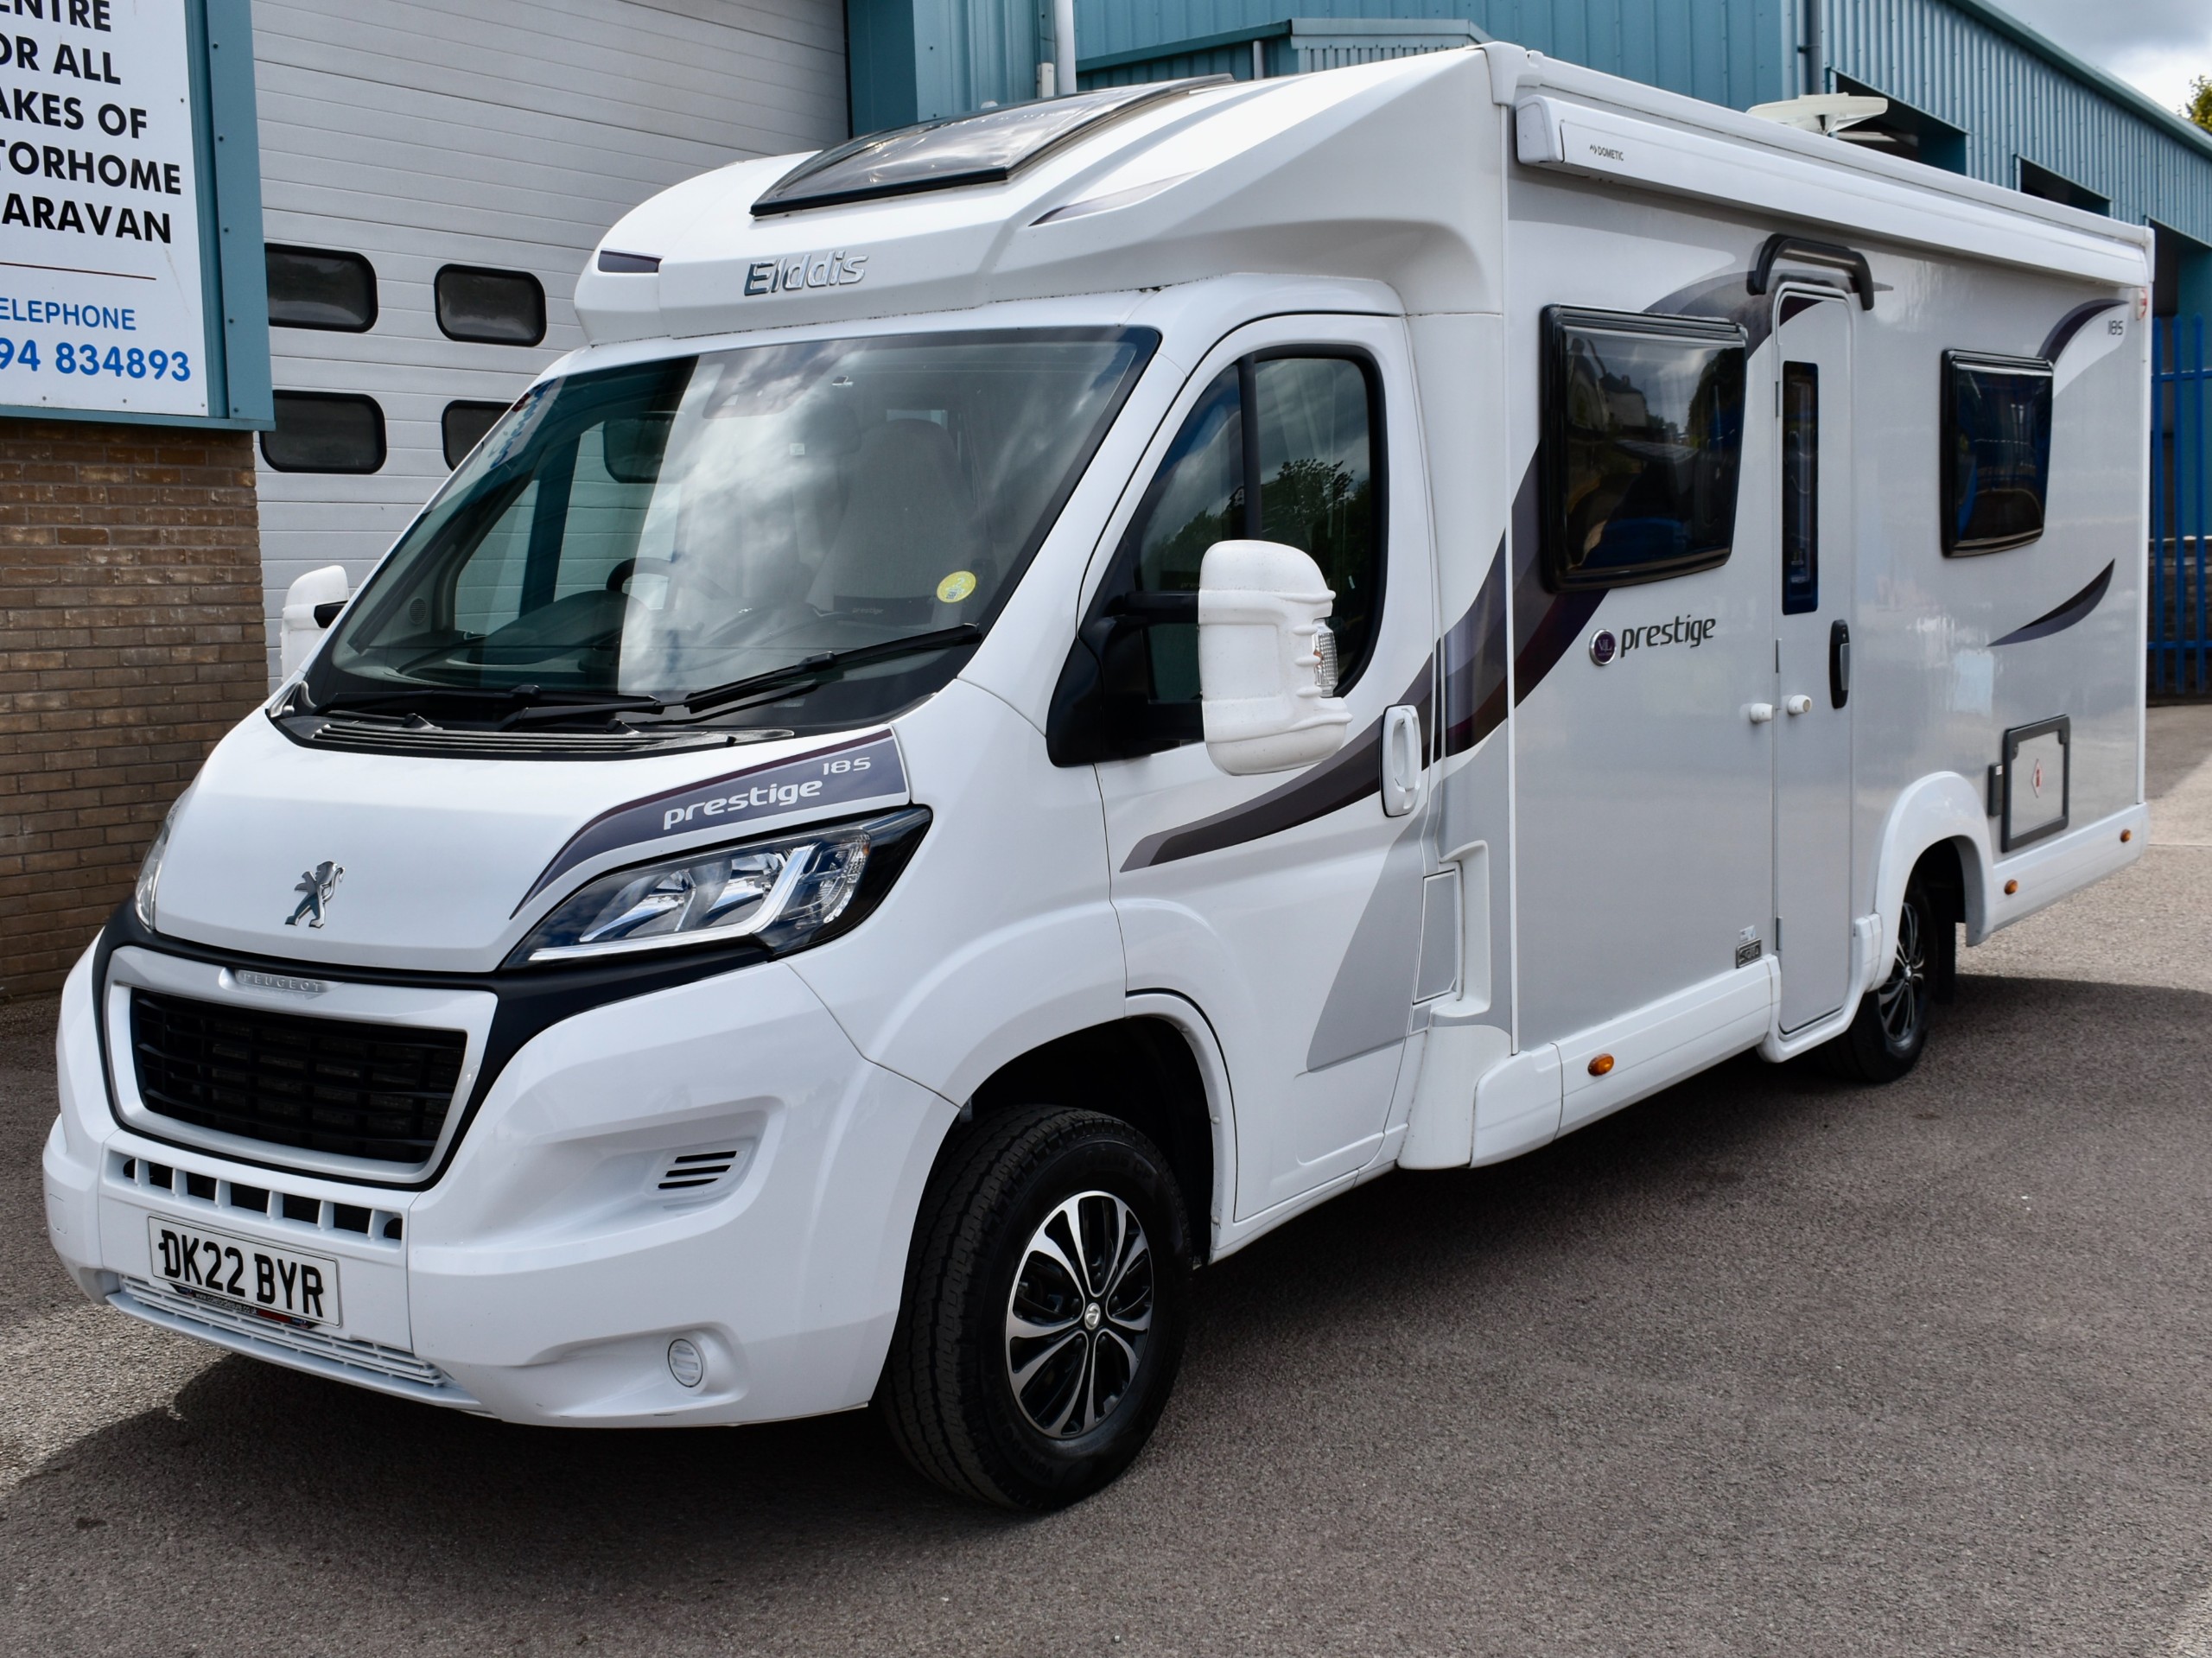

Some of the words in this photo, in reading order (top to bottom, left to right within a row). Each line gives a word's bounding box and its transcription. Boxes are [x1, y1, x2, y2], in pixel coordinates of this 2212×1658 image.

[53, 43, 121, 85] ALL
[98, 103, 147, 139] OF
[0, 138, 181, 195] ORHOME
[1598, 145, 1624, 162] DOMETIC
[2, 193, 171, 244] ARAVAN
[744, 250, 869, 296] Elddis
[0, 338, 41, 372] 94
[55, 342, 191, 382] 834893
[1620, 614, 1716, 658] prestige
[663, 780, 823, 830] prestige
[243, 973, 322, 993] PEUGEOT
[160, 1229, 245, 1298] DK22
[254, 1253, 324, 1318] BYR
